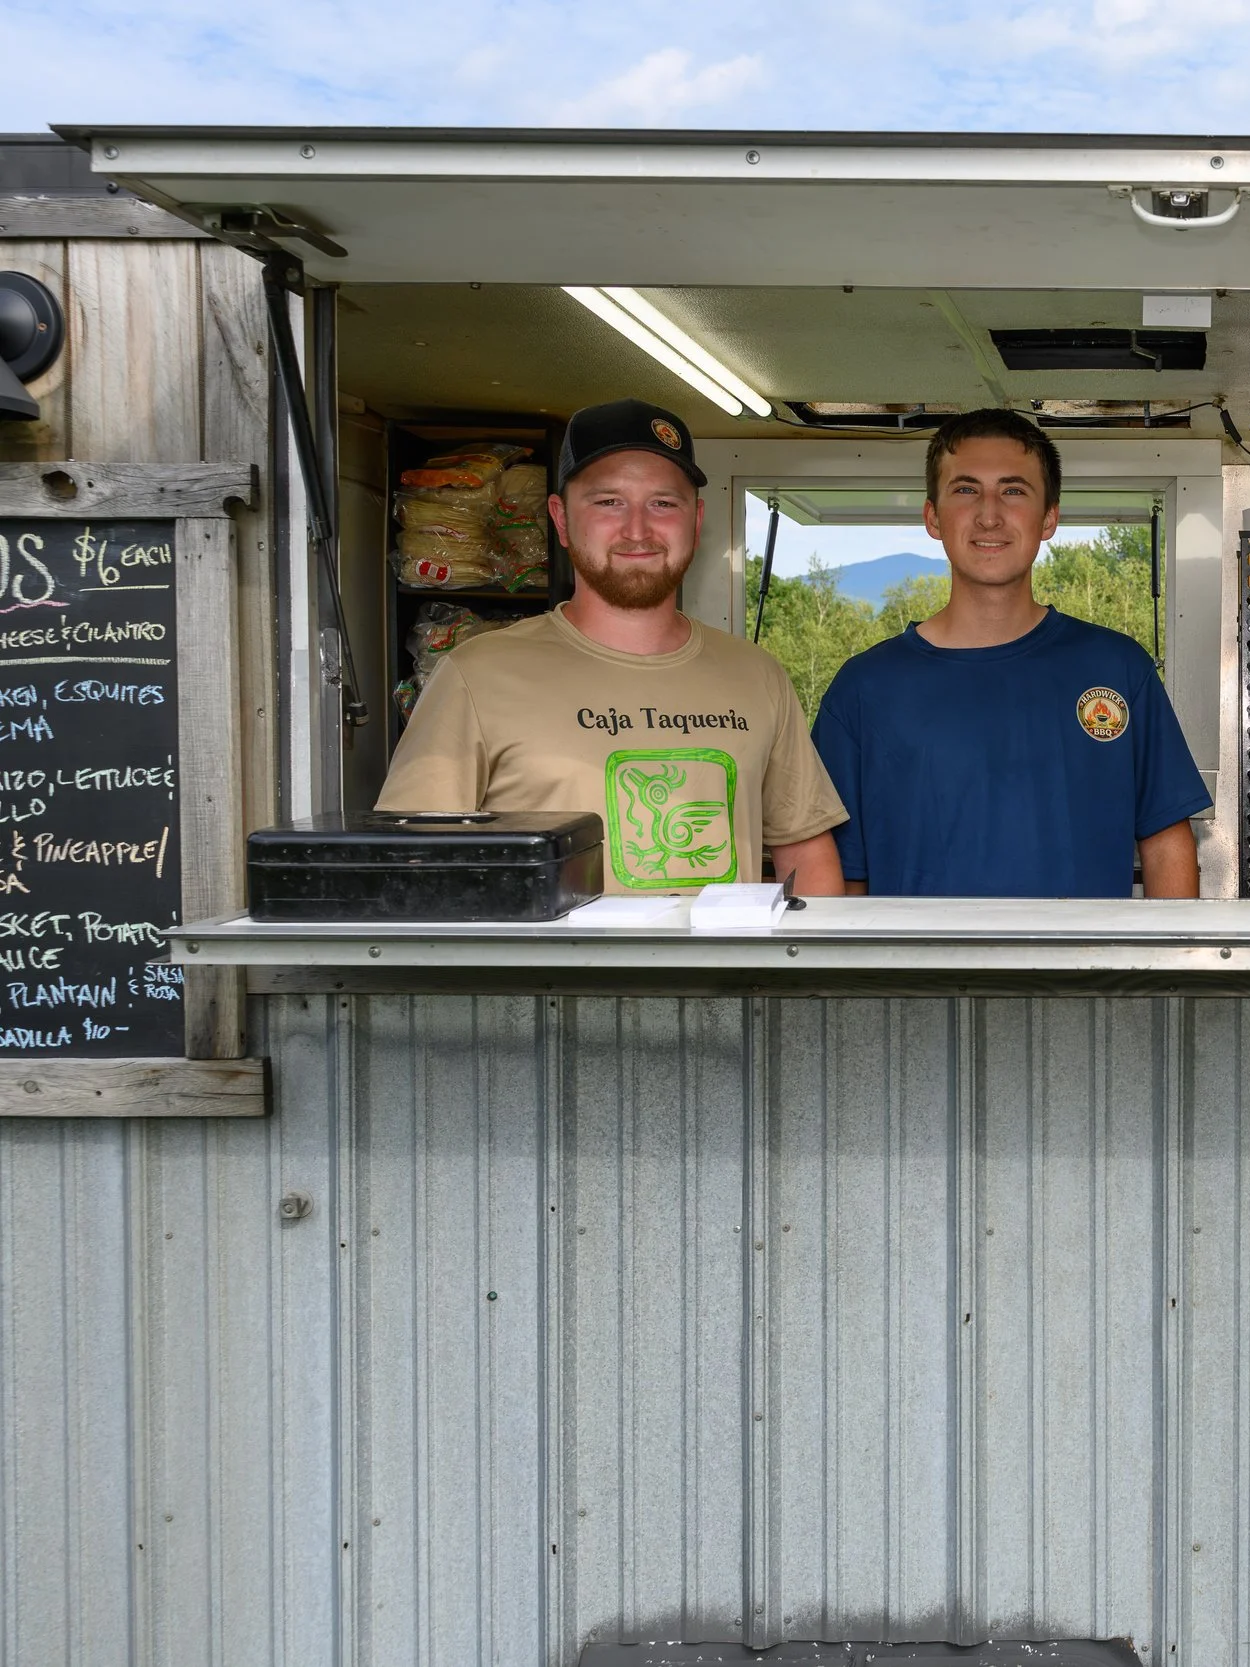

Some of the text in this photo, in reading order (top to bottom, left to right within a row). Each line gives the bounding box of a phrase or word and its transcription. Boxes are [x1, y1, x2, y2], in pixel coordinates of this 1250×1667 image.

[73, 526, 120, 586] $6
[121, 543, 171, 567] EACH
[73, 621, 166, 643] CILANTRO
[54, 679, 165, 705] ESQUITES
[1081, 690, 1123, 705] HARDWICK
[577, 707, 750, 737] Caja Taqueria
[1093, 728, 1113, 738] BBQ
[6, 976, 117, 1010] PLANTAIN
[143, 983, 181, 1001] ROJA
